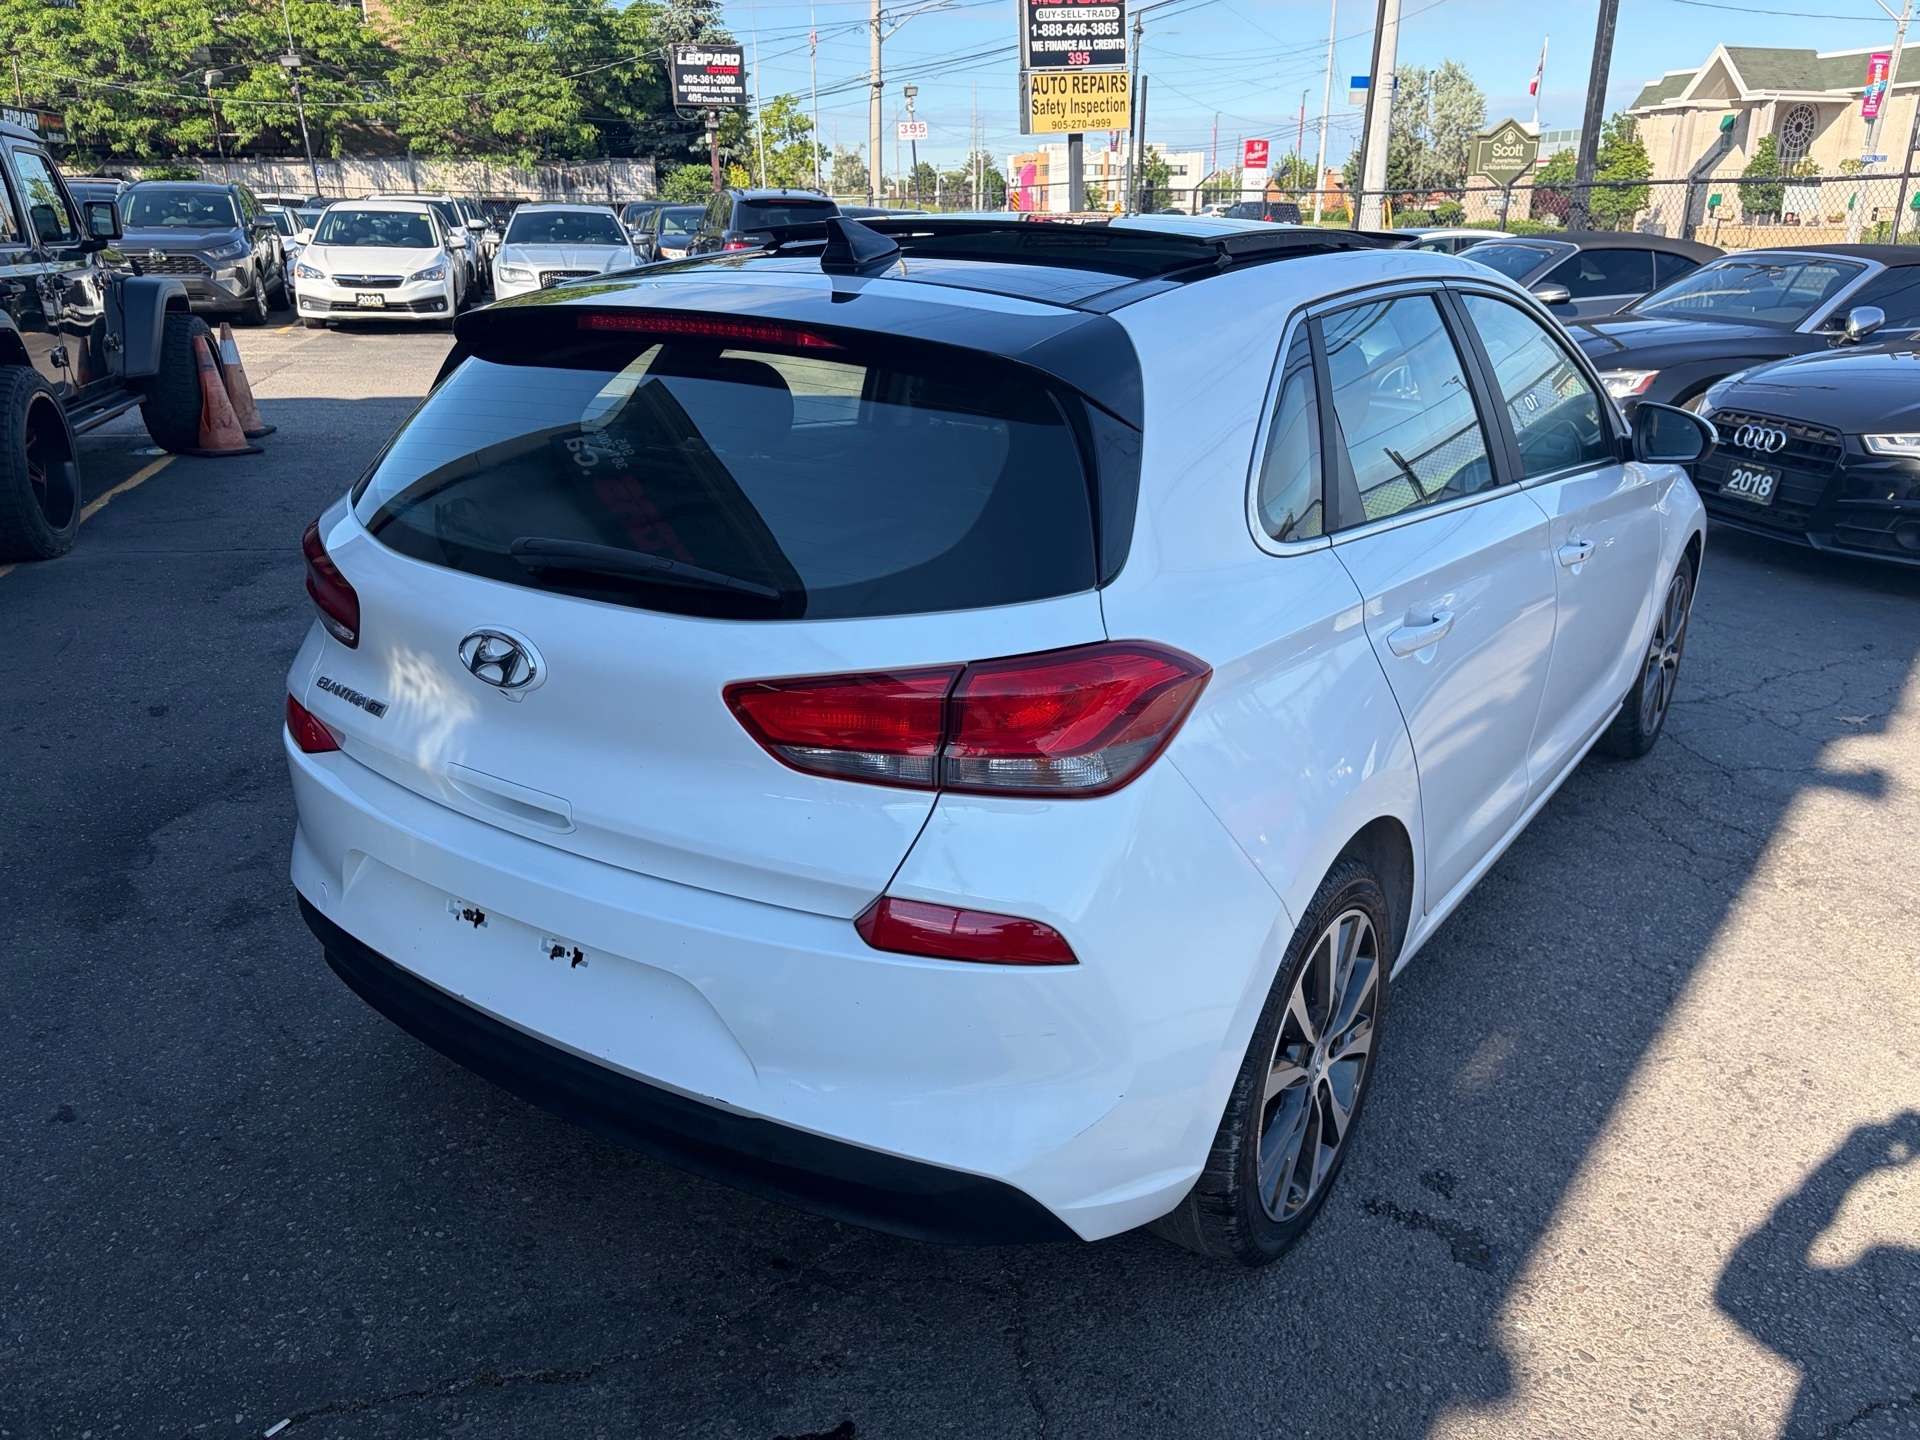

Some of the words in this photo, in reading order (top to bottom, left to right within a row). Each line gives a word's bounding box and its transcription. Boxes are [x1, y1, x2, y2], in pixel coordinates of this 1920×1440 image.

[1038, 8, 1117, 19] BUY-SELL-TRADE
[1031, 22, 1119, 37] 1-888-646-3865
[1031, 41, 1044, 52] WE
[1045, 40, 1078, 52] FINANCE
[1078, 39, 1093, 51] ALL
[1093, 38, 1125, 50] CREDITS
[677, 52, 740, 66] LEOPARD
[1067, 52, 1090, 65] 395
[682, 74, 736, 85] 905-361-2000
[1032, 77, 1067, 95] AUTO
[1072, 75, 1127, 94] REPAIRS
[687, 93, 702, 103] 405
[1032, 99, 1067, 118] Safety
[1070, 97, 1126, 117] Inspection
[2, 109, 39, 130] EOPARD
[1051, 118, 1111, 130] 905-270-4999
[900, 123, 926, 135] 395
[1491, 143, 1524, 157] Scott
[359, 295, 383, 305] 2020
[1728, 468, 1773, 496] 2018
